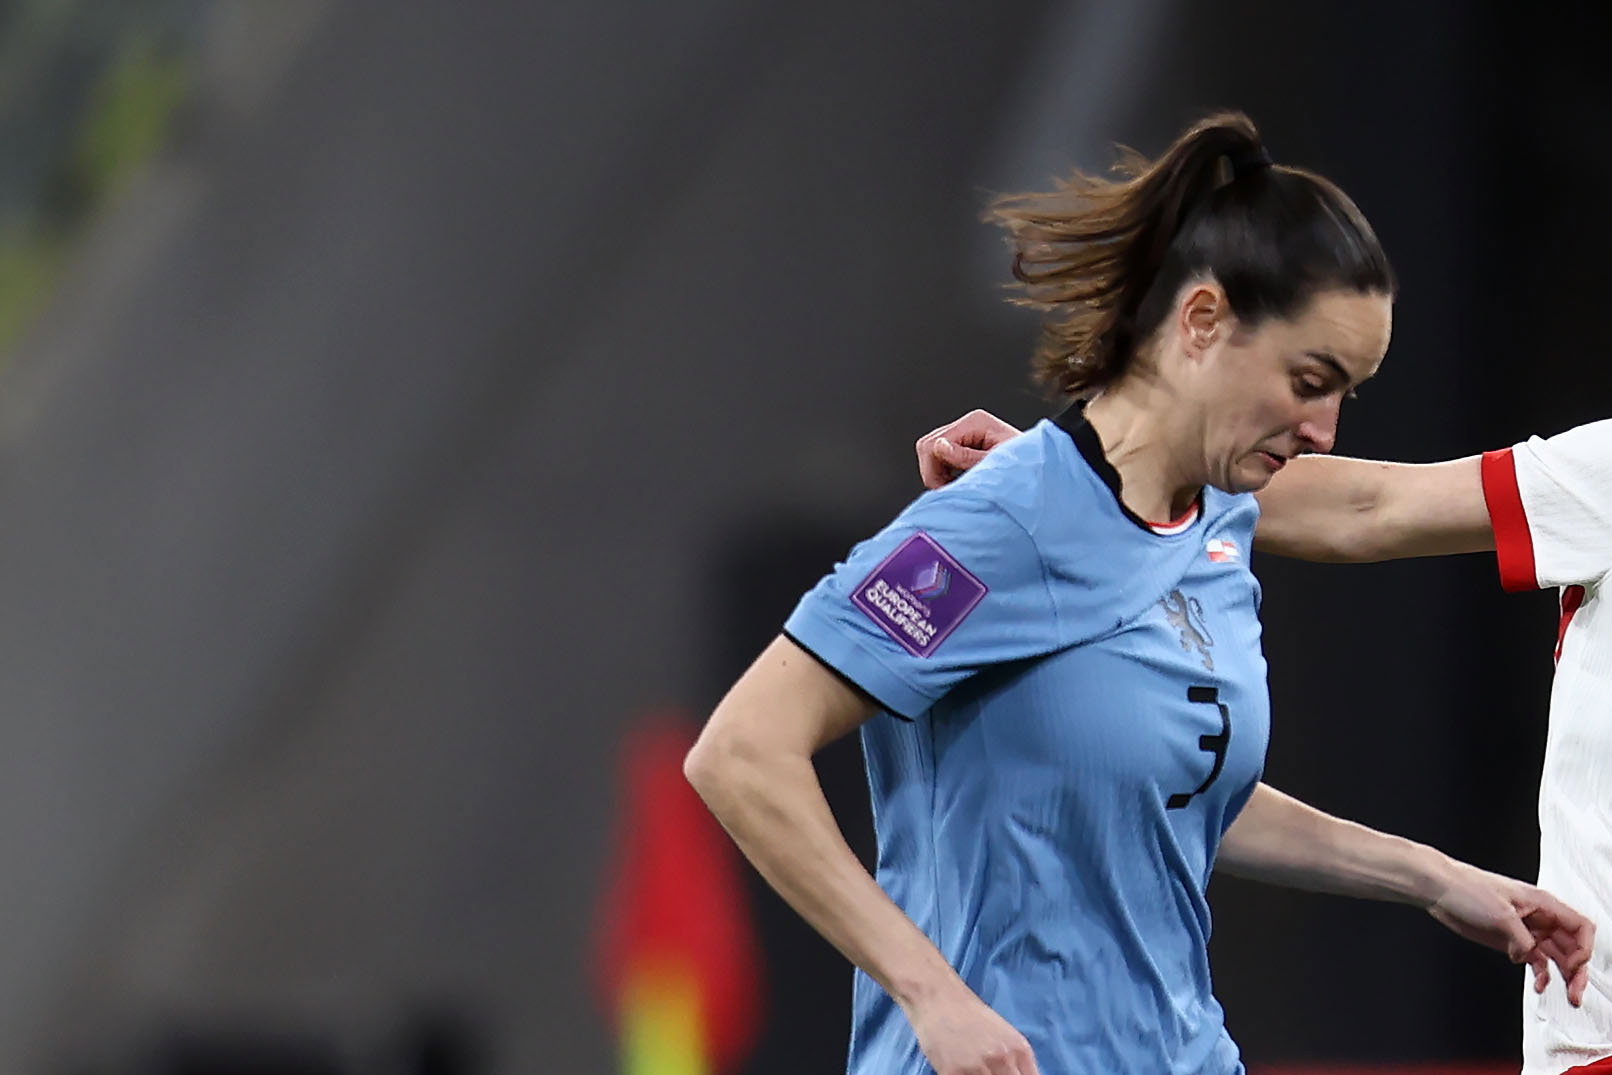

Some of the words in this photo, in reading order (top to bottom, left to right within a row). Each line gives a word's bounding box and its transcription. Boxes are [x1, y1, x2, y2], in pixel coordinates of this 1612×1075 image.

[865, 587, 931, 646] QUALIFIERS
[876, 579, 937, 636] EUROPEAN
[1167, 686, 1231, 809] 3
